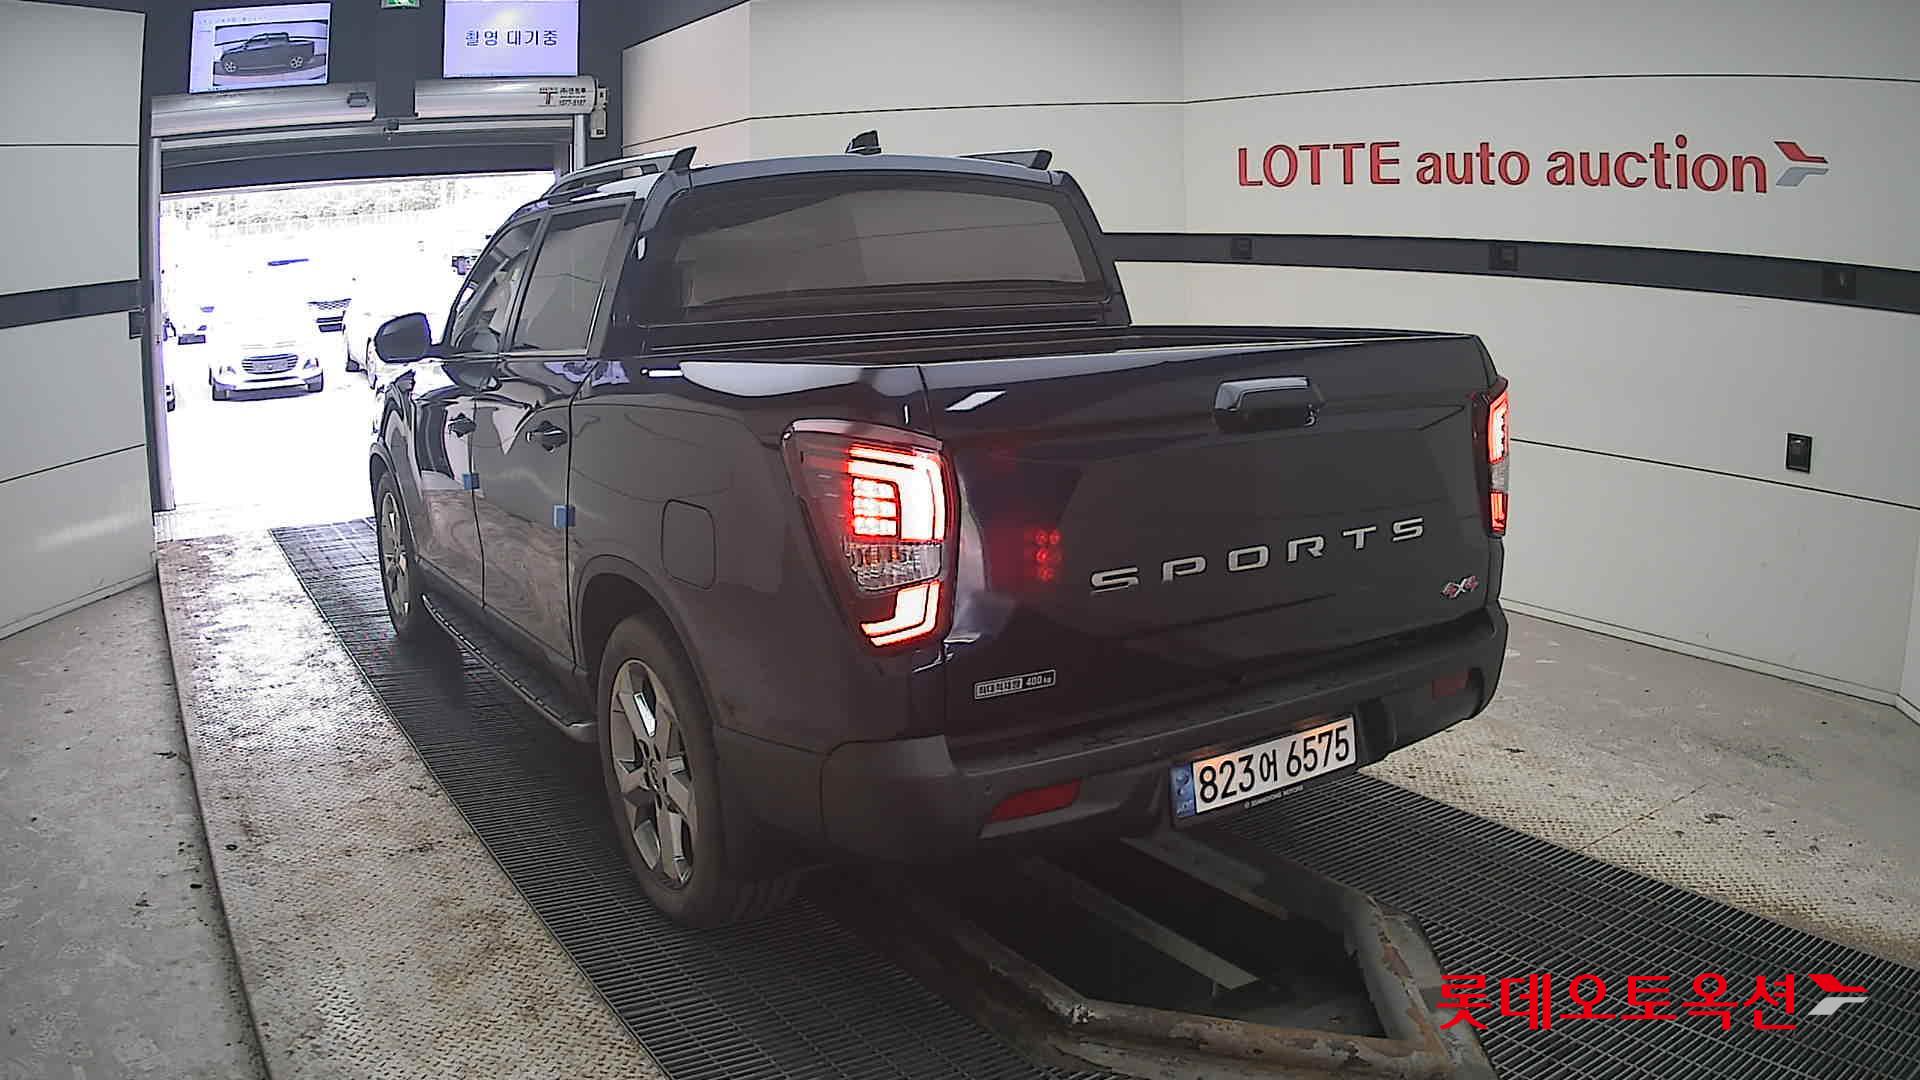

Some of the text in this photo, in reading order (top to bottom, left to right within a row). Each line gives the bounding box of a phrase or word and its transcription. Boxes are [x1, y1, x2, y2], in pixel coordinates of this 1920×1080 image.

[507, 30, 558, 46] 대기중
[1237, 134, 1768, 193] LOTTE auto auction
[1090, 517, 1425, 594] SPORTS
[1199, 724, 1350, 804] 823어 6575
